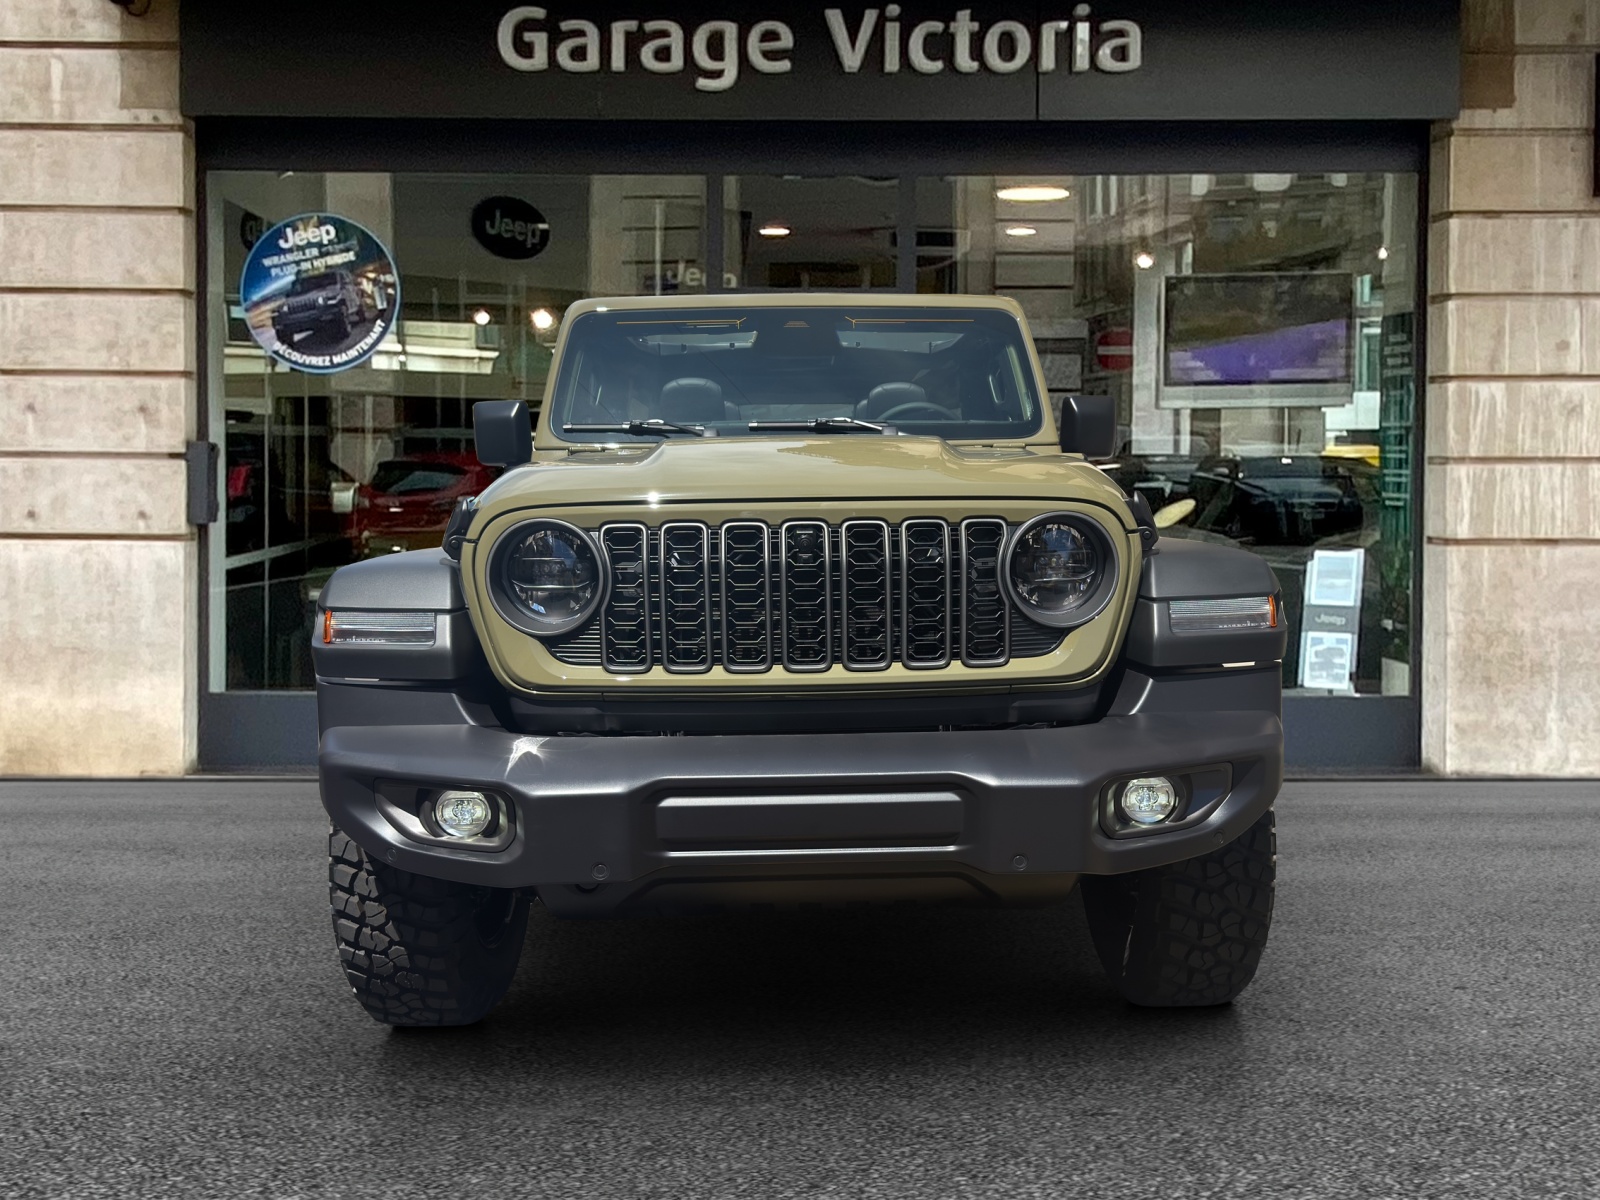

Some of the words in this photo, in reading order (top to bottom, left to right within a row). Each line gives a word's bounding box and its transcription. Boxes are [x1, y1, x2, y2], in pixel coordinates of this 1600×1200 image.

[497, 6, 794, 91] Garage
[824, 3, 1143, 74] Victoria
[278, 224, 337, 249] Jeep
[484, 209, 541, 248] Jeep
[262, 247, 320, 268] WRANGLER
[666, 260, 737, 288] Jep
